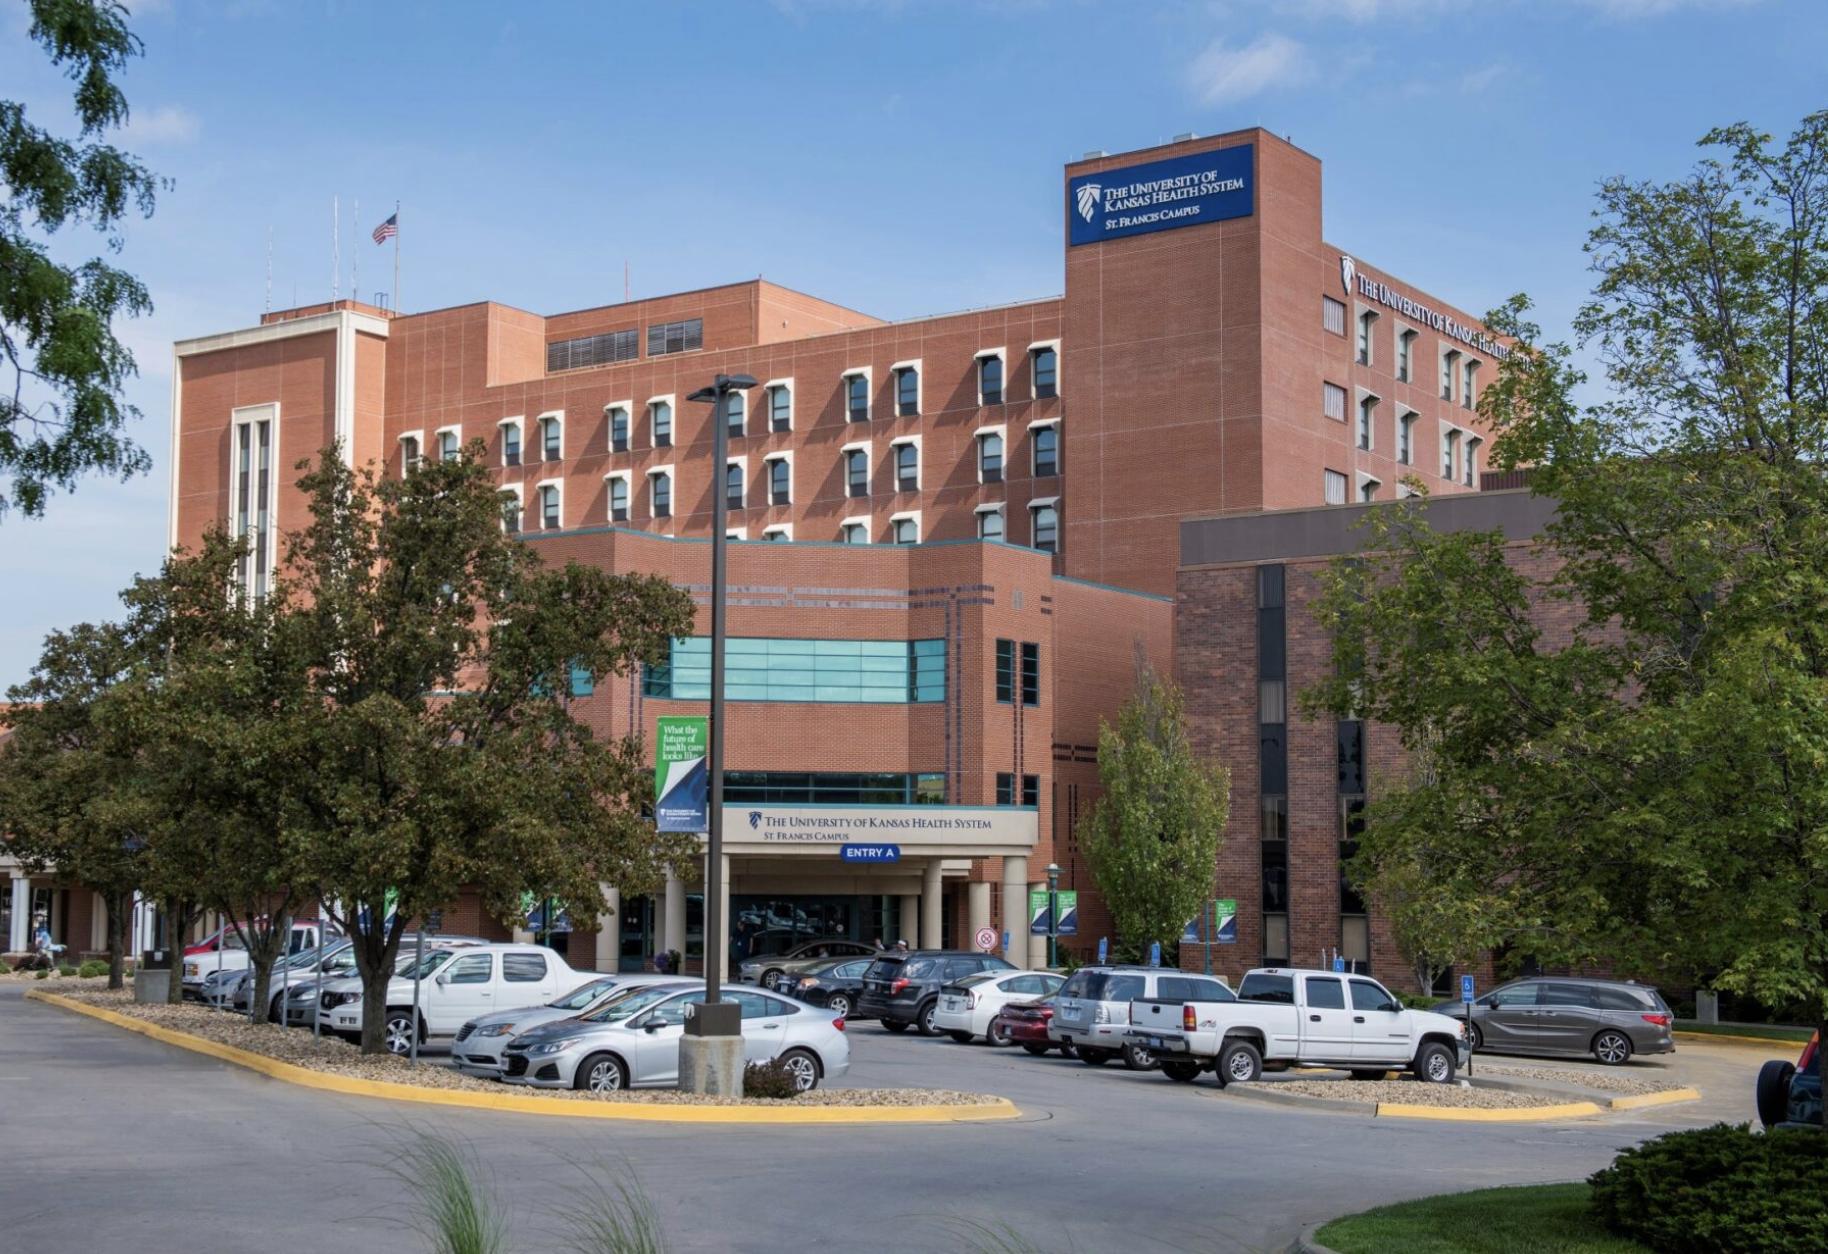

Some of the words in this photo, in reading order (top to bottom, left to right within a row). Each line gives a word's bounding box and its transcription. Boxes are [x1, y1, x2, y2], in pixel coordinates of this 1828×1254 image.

[1104, 188, 1128, 200] THE
[1130, 173, 1201, 196] UNIVERSITY
[1201, 170, 1217, 182] OF
[1104, 195, 1151, 213] KANSAS
[1152, 185, 1200, 204] HEALTH
[1200, 178, 1244, 196] SYSTEM
[1105, 219, 1118, 230] ST.
[1120, 212, 1159, 227] FRANCIS
[1160, 205, 1200, 220] CAMPUS
[1357, 272, 1378, 300] THE
[1379, 283, 1432, 324] UNIVERSITY
[1432, 312, 1444, 331] OF
[663, 725, 684, 734] What
[685, 725, 698, 734] the
[663, 734, 686, 743] future
[687, 734, 696, 743] of
[663, 742, 686, 751] health
[663, 751, 683, 760] looks
[764, 816, 787, 827] THE
[789, 816, 852, 827] UNIVERSITY
[853, 818, 868, 828] OF
[869, 817, 910, 828] KANSAS
[912, 818, 952, 828] HEALTH
[954, 818, 992, 829] SYSTEM
[777, 831, 813, 840] FRANCIS
[814, 831, 850, 841] CAMPUS
[846, 848, 883, 858] ENTRY
[885, 848, 894, 858] A
